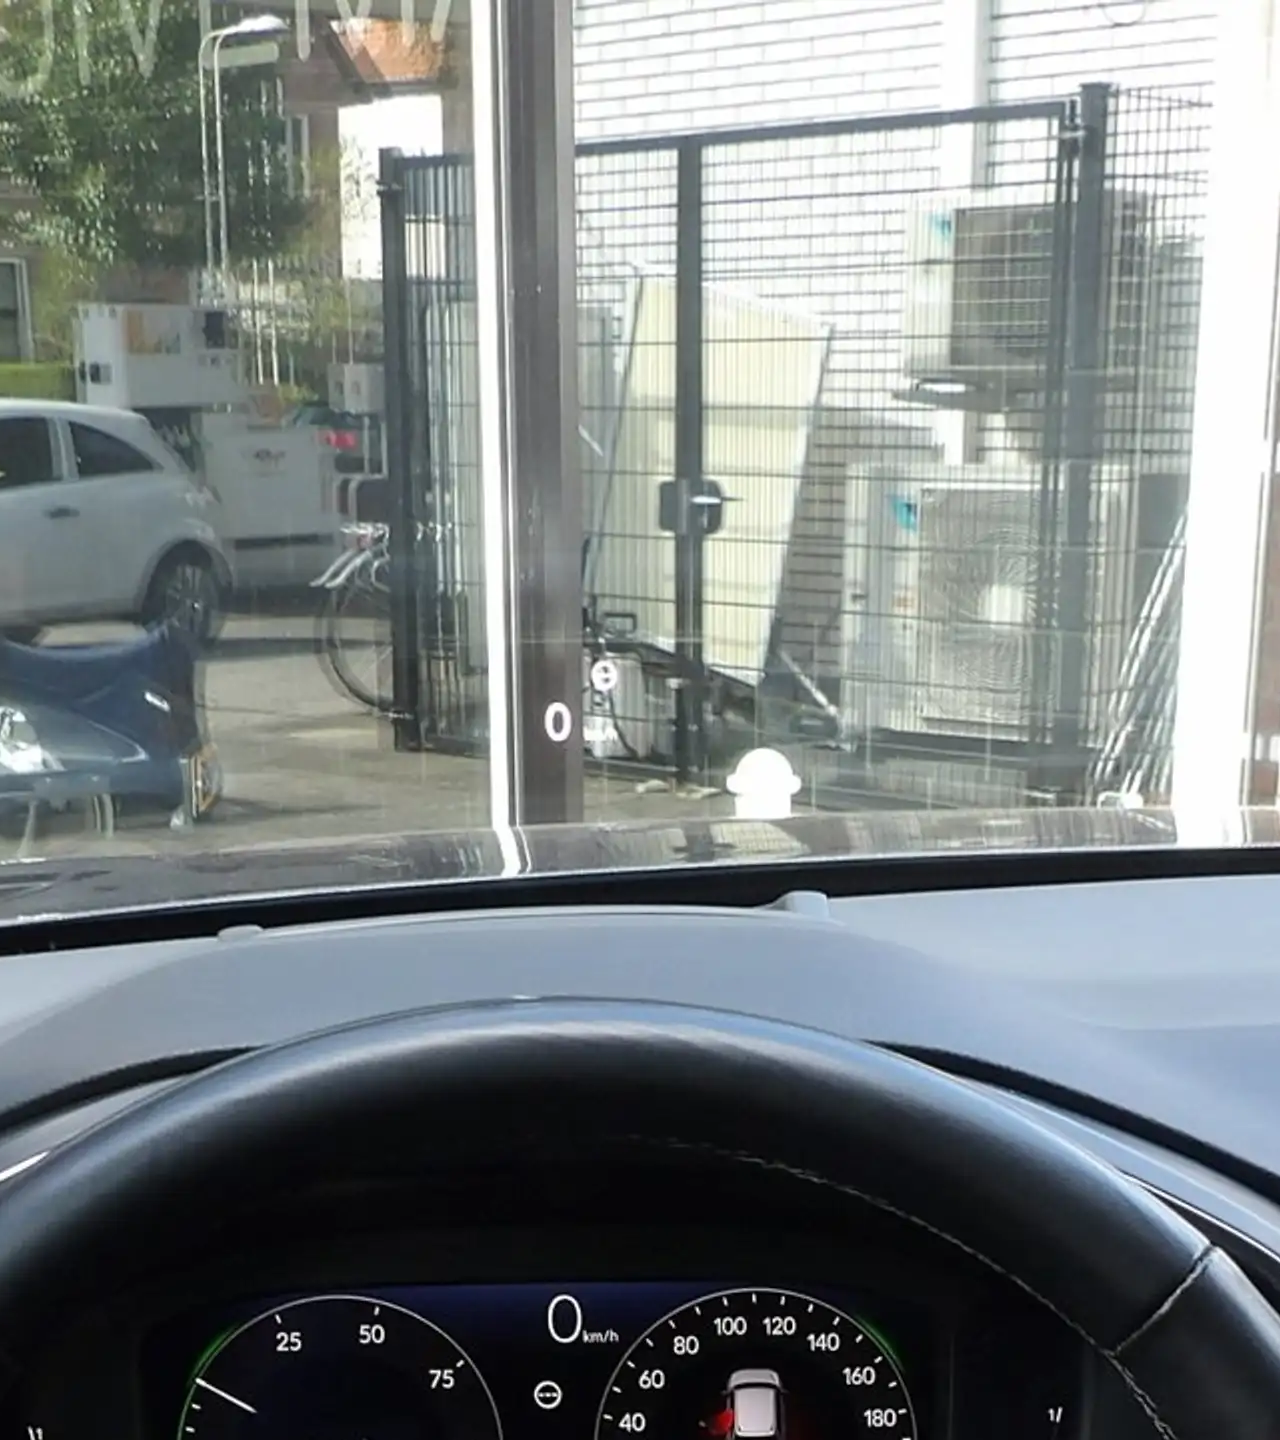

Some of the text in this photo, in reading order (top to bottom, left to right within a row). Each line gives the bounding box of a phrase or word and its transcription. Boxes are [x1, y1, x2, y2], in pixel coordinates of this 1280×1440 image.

[547, 1294, 620, 1344] 0 km/h
[713, 1316, 748, 1336] 100
[762, 1315, 797, 1336] 120
[275, 1331, 302, 1352] 25
[359, 1324, 386, 1345] 50
[806, 1332, 840, 1352] 140
[673, 1335, 700, 1356] 80
[428, 1369, 455, 1389] 75
[638, 1369, 665, 1390] 60
[842, 1365, 876, 1386] 160
[618, 1412, 646, 1433] 40
[863, 1407, 897, 1428] 180
